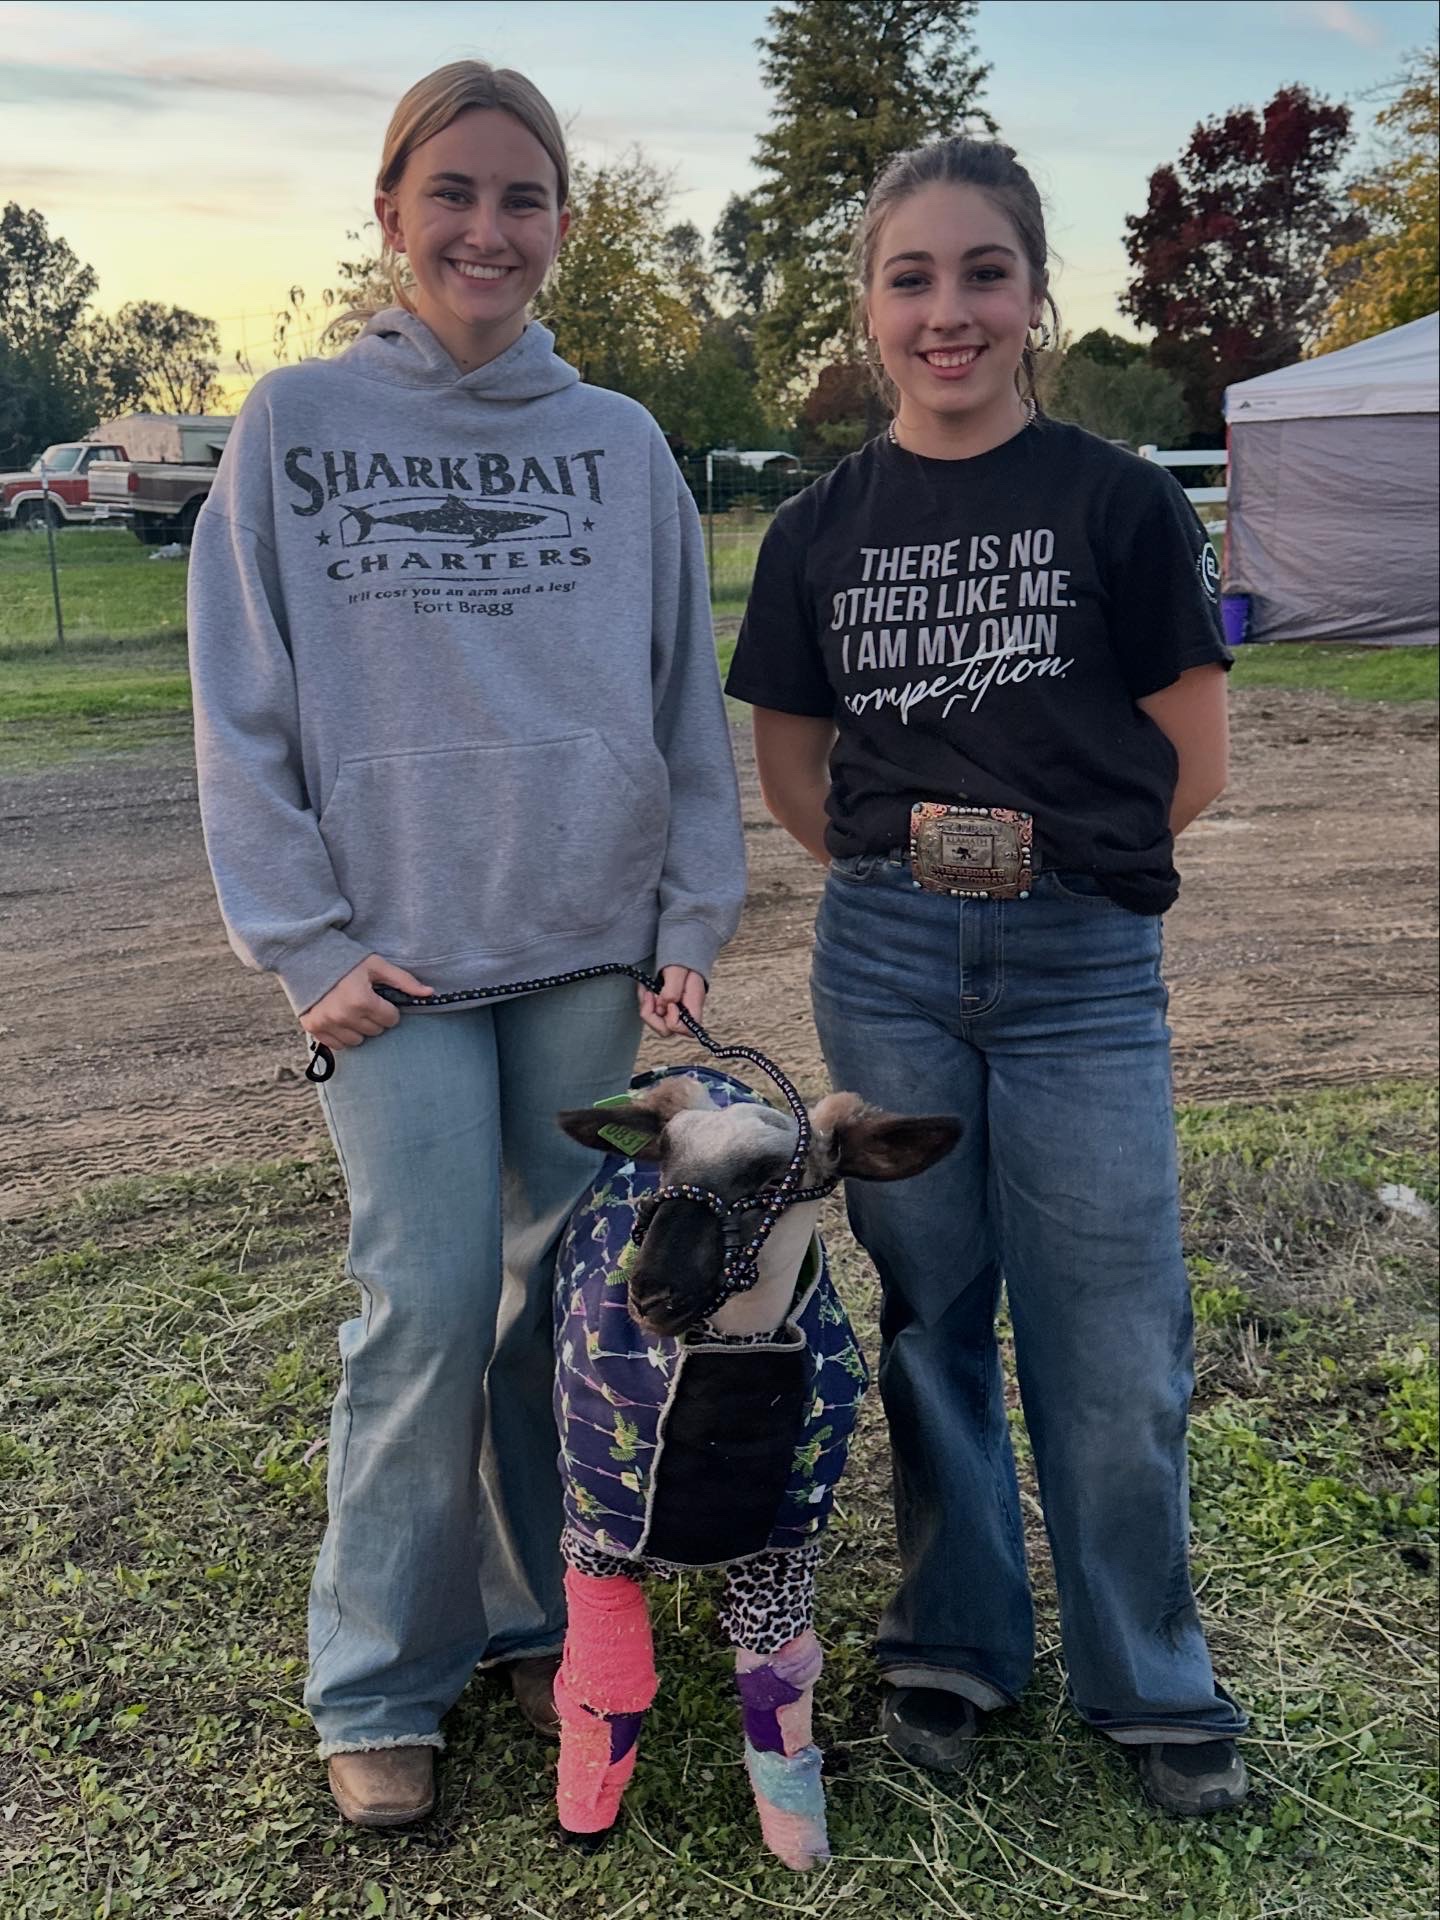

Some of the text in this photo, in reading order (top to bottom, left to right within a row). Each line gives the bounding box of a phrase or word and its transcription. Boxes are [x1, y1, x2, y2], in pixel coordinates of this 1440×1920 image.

[326, 547, 592, 580] CHARTERS
[860, 529, 1055, 581] THERE IS NO
[375, 589, 408, 600] cost
[412, 588, 441, 599] you
[446, 588, 464, 597] an
[468, 588, 498, 597] arm
[502, 584, 532, 596] and
[535, 585, 545, 593] a
[414, 601, 514, 616] Fort Bragg
[831, 570, 1077, 630] OTHER LIKE ME.
[842, 613, 1058, 674] I AM MY OWN
